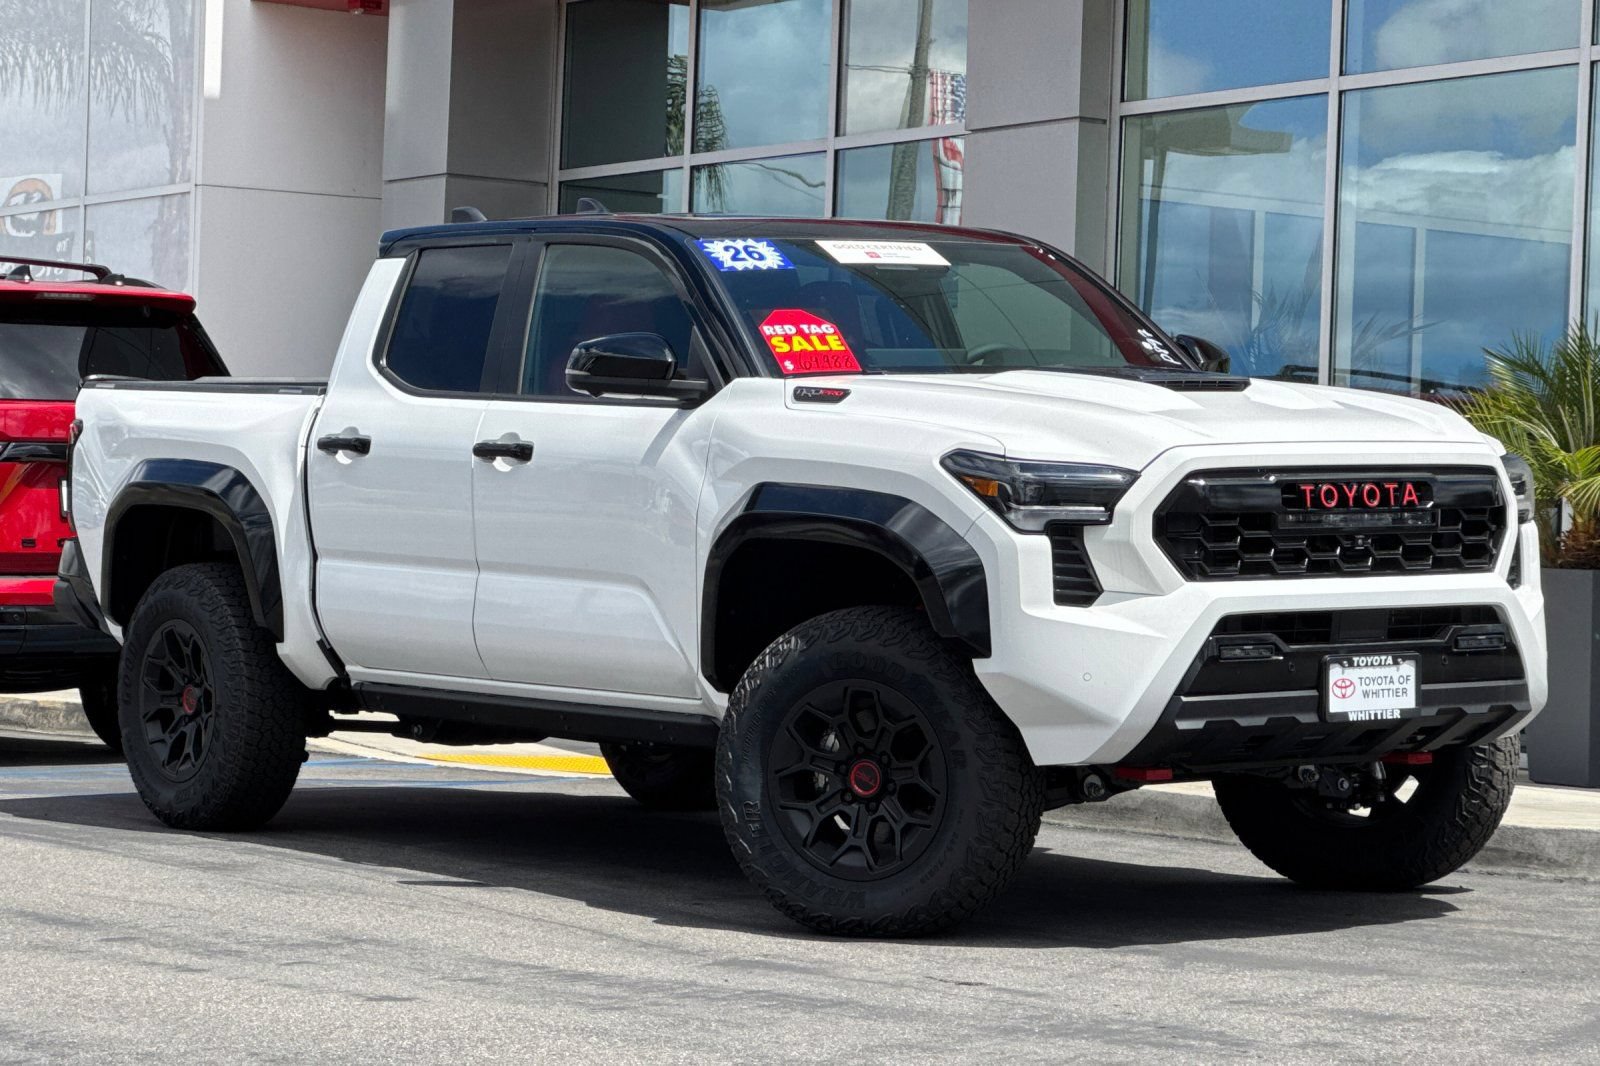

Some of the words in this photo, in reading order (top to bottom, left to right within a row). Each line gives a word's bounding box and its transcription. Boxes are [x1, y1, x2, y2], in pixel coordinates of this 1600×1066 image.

[723, 245, 767, 262] 26
[762, 325, 797, 335] RED
[800, 324, 835, 334] TAG
[770, 335, 846, 352] SALE
[1299, 483, 1419, 508] TOYOTA
[1352, 655, 1394, 667] TOYOTA
[1358, 676, 1395, 687] TOYOTA
[1397, 675, 1412, 685] OF
[1361, 688, 1408, 699] WHITTIER
[1348, 709, 1401, 721] WHITTIER
